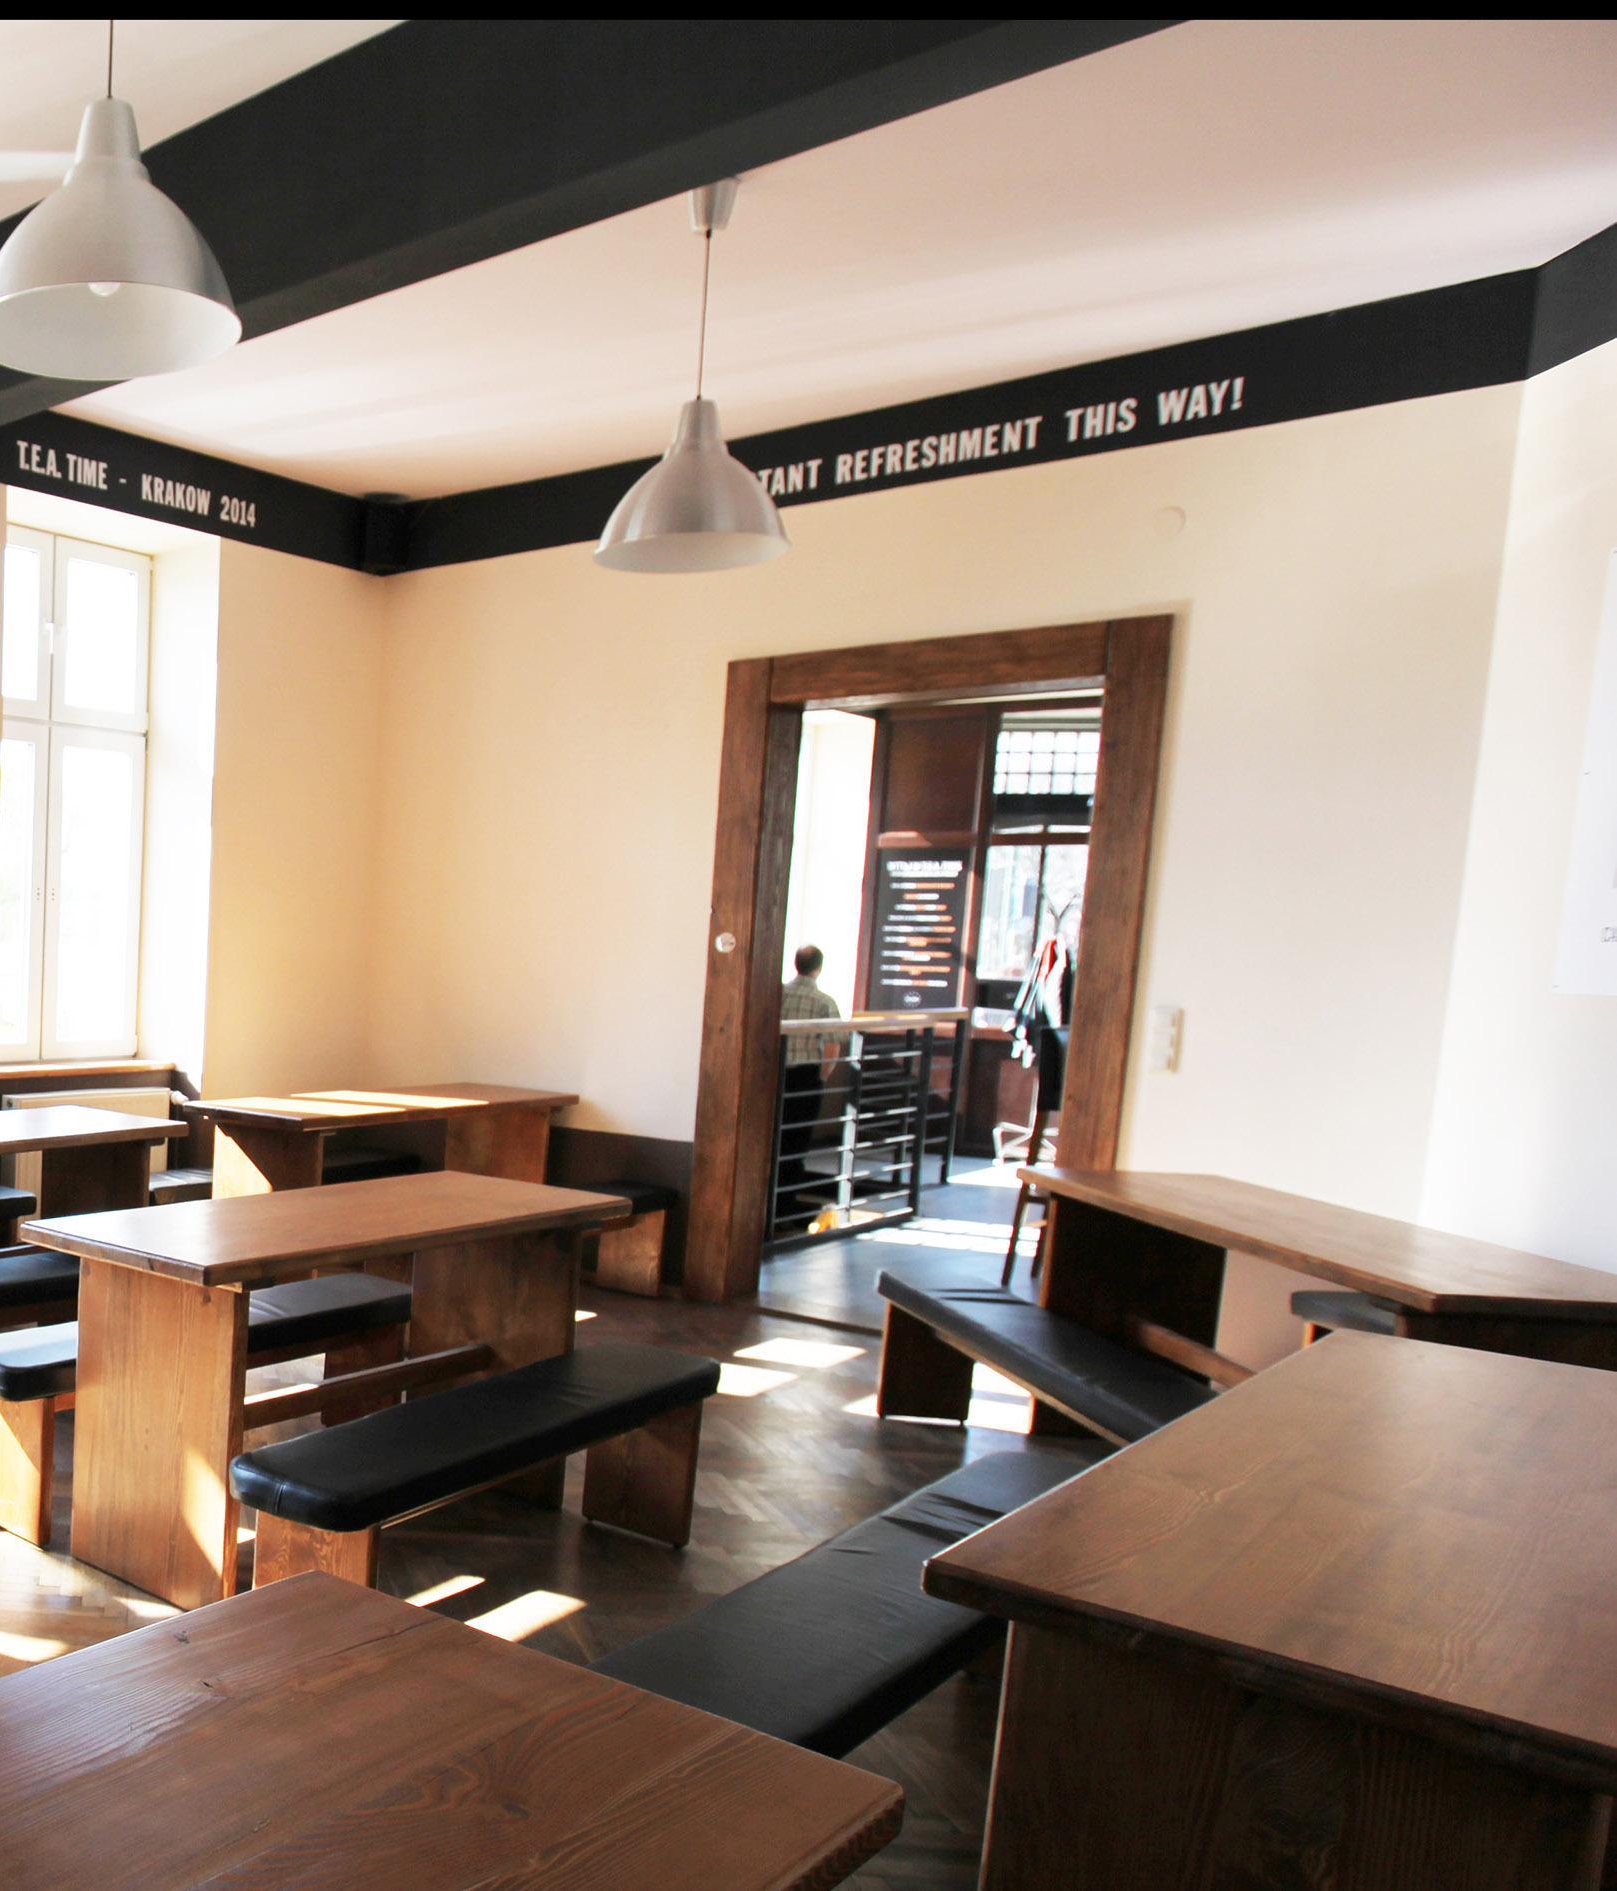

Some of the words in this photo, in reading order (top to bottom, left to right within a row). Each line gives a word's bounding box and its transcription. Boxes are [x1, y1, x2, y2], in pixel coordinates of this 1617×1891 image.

[835, 415, 1042, 484] REFRESHMENT
[1065, 397, 1137, 441] THIS
[1157, 376, 1245, 425] WAY!
[66, 453, 108, 490] TIME
[142, 473, 211, 515] KRAKOW
[220, 496, 256, 527] 2014
